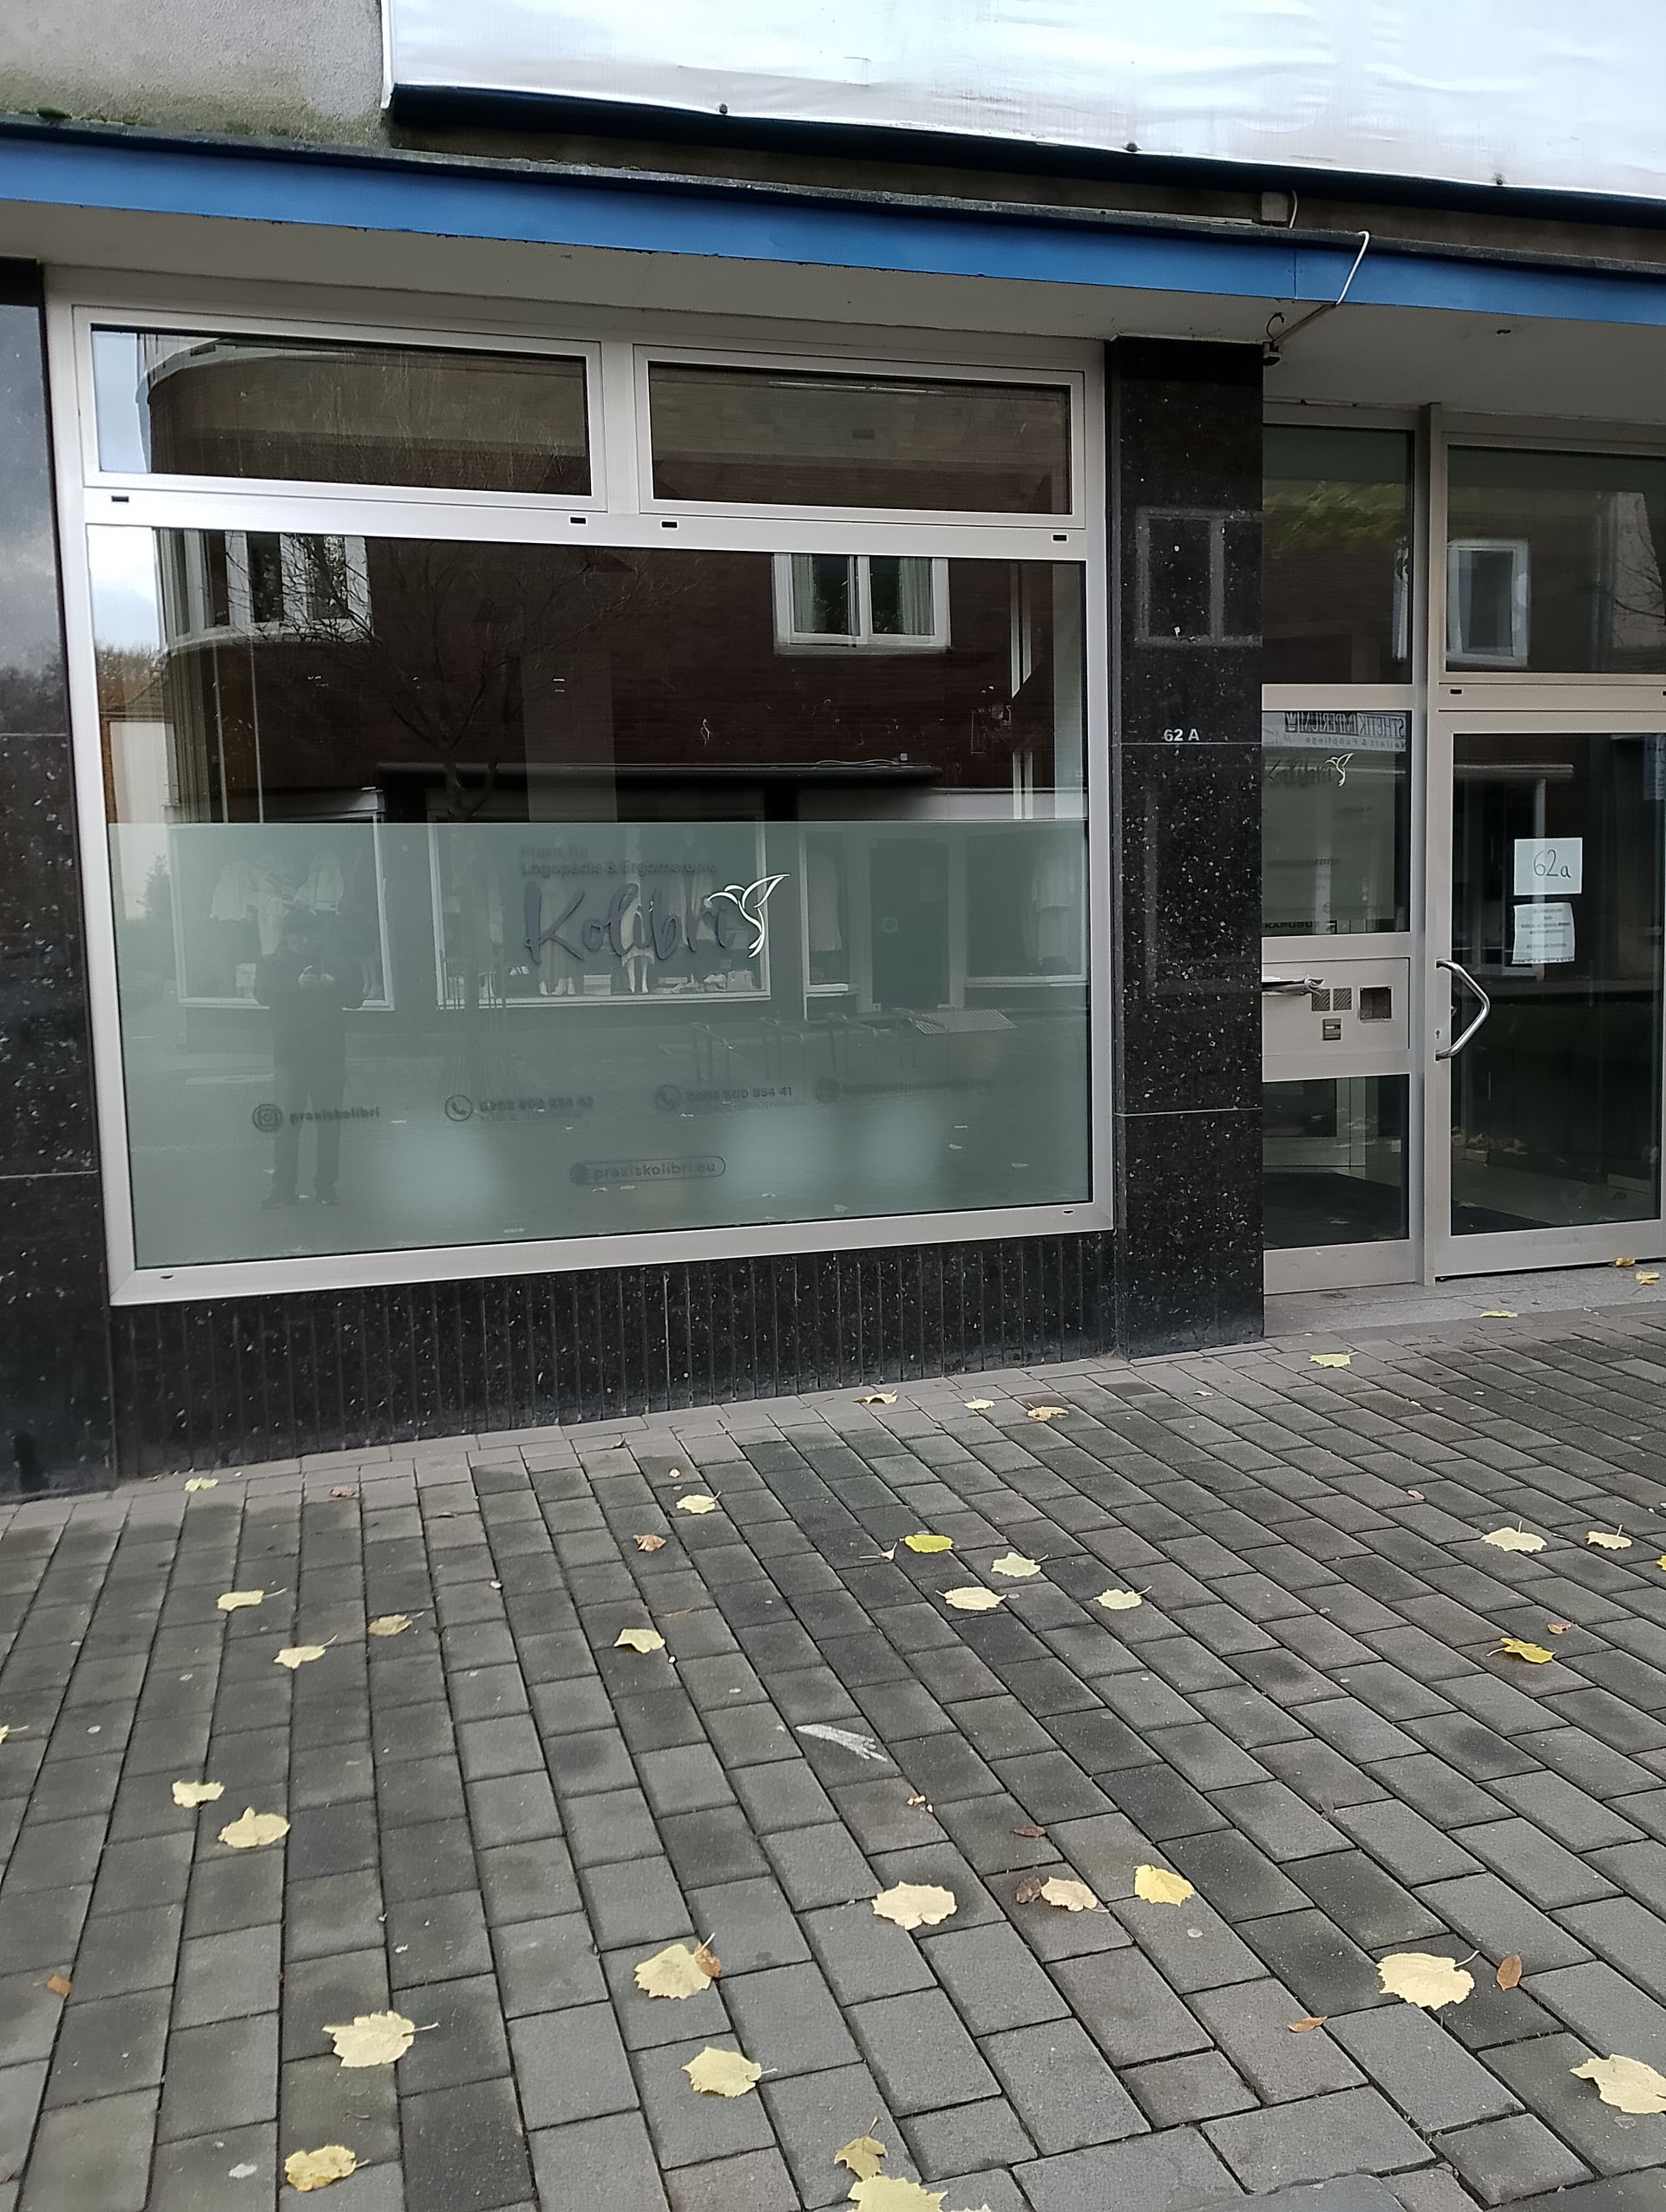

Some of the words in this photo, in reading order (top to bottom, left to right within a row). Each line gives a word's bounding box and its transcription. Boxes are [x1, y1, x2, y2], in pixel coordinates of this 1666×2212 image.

[1164, 729, 1184, 742] 62
[1187, 728, 1200, 741] A
[1533, 849, 1571, 879] 62a
